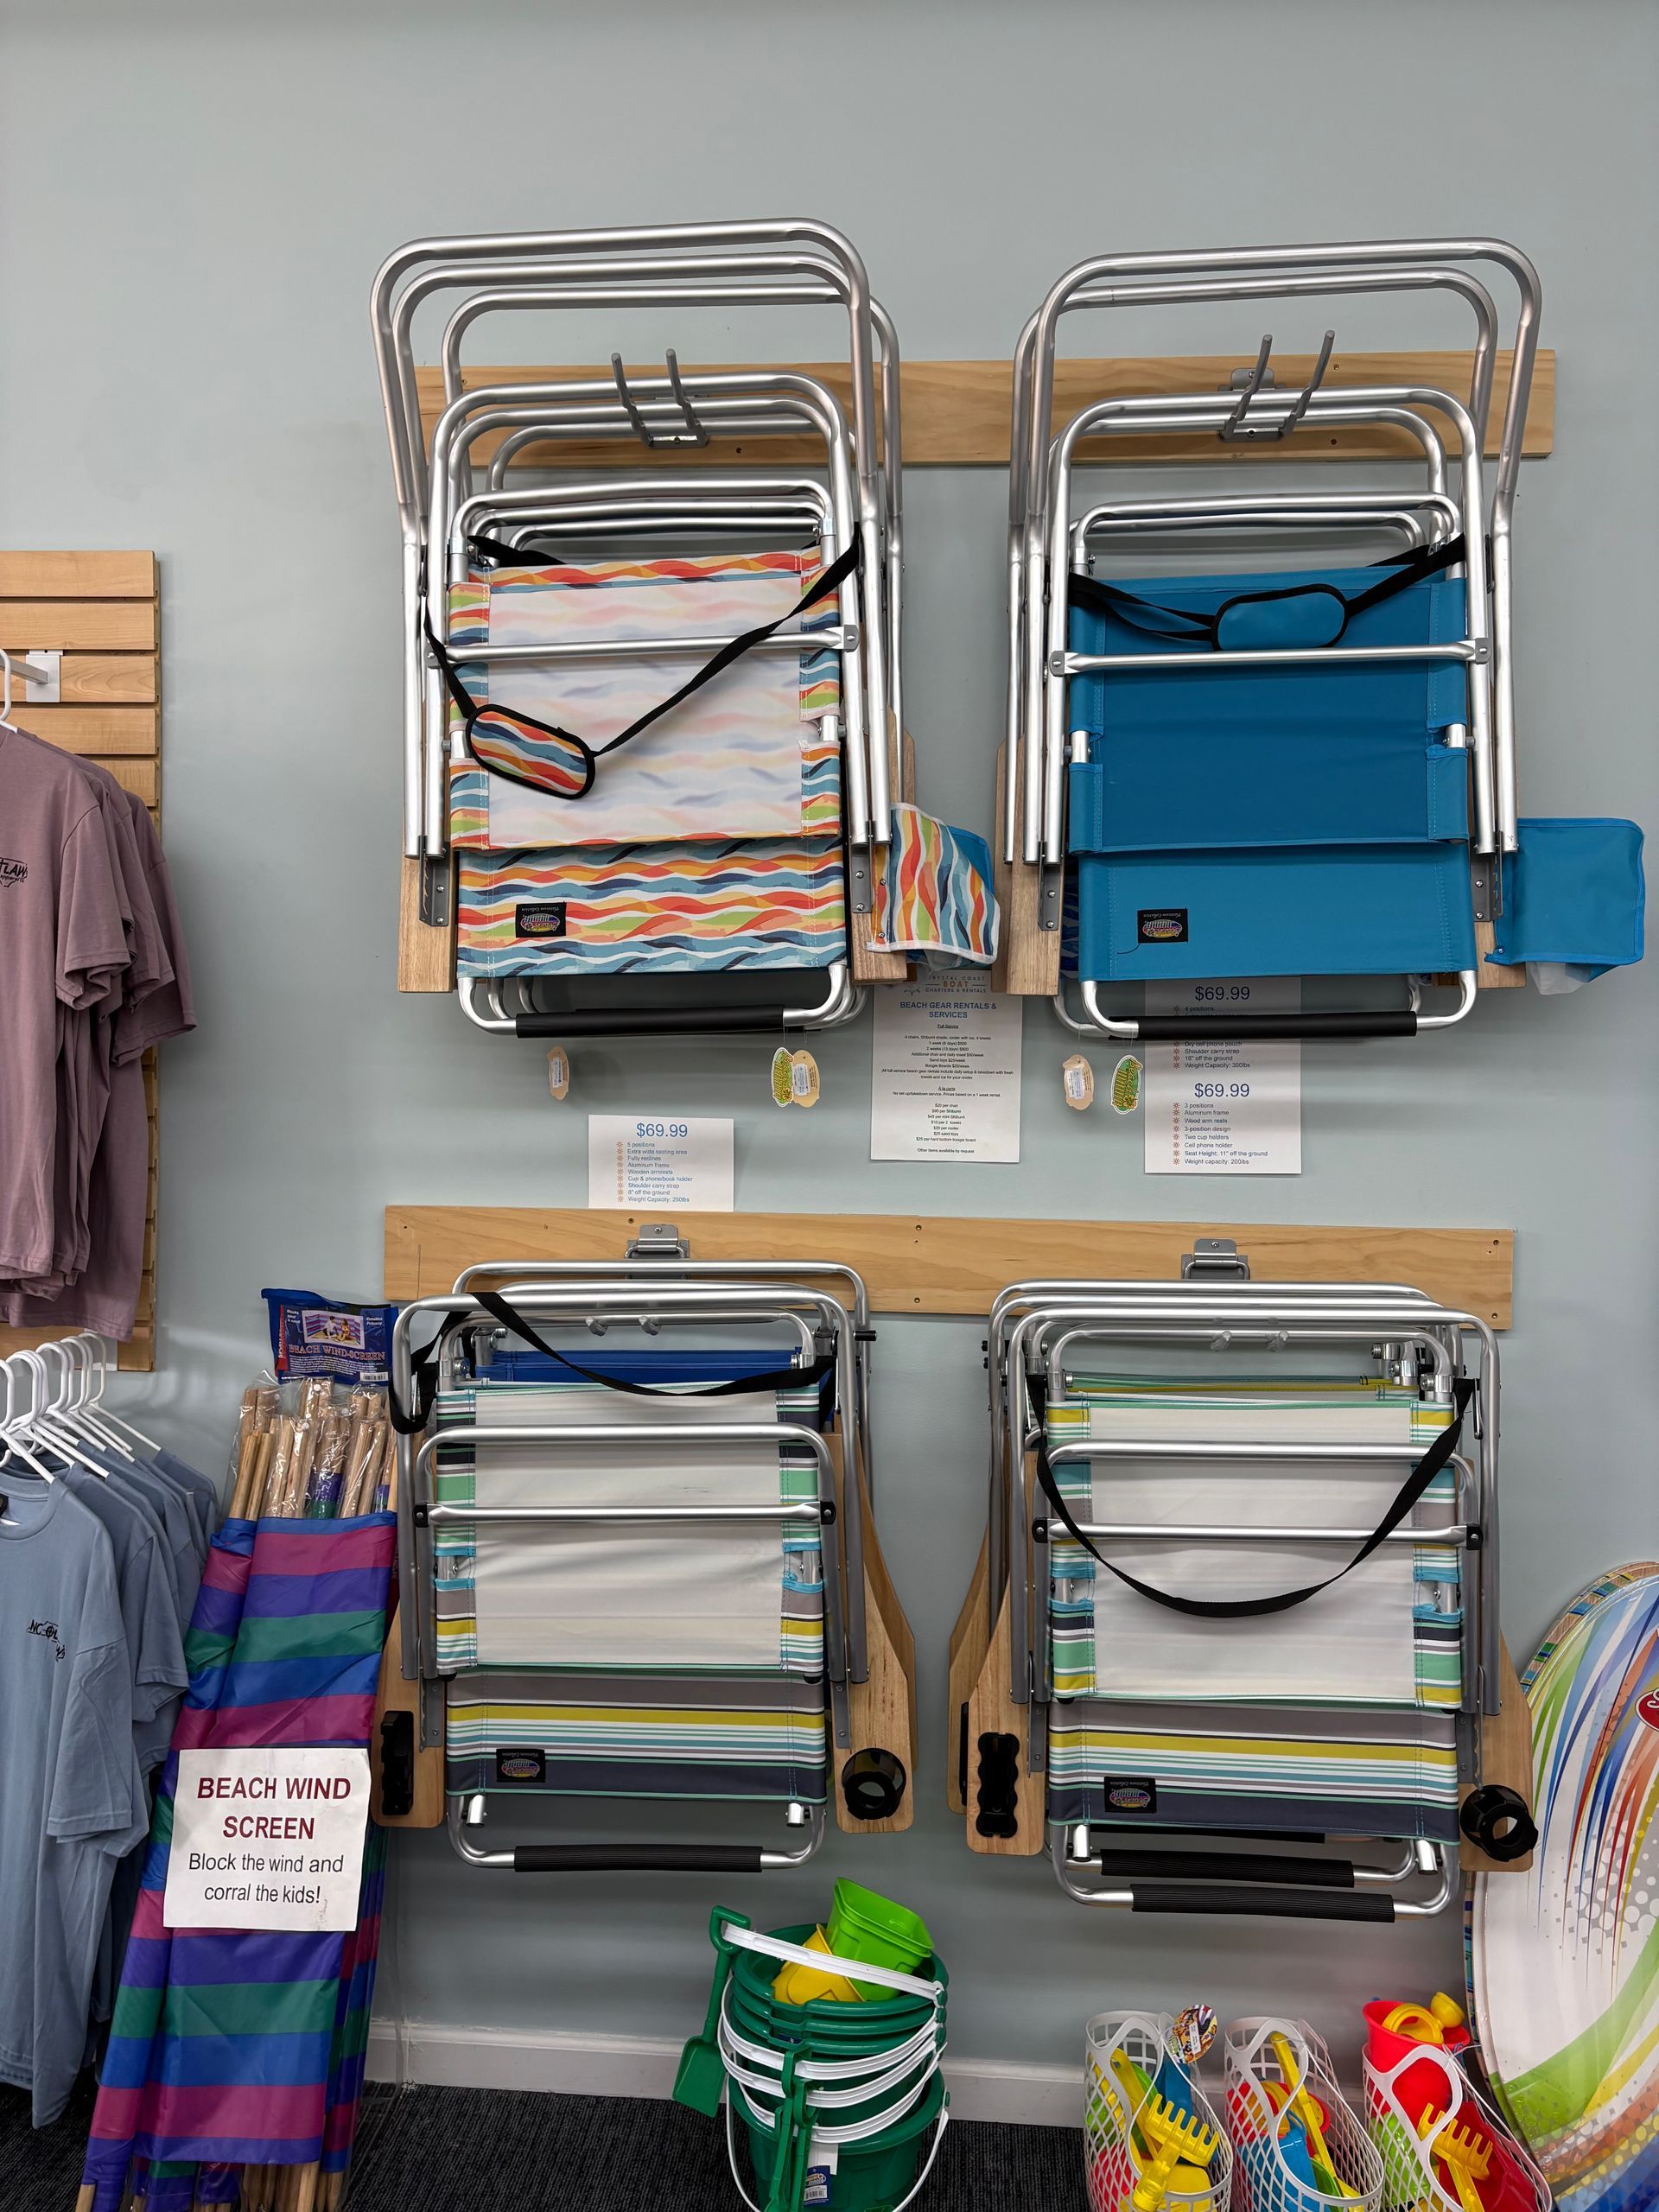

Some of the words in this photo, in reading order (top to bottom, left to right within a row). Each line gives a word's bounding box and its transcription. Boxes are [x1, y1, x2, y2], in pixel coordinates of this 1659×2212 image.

[1195, 987, 1250, 1002] $69.99
[1194, 1083, 1249, 1098] $69.99
[636, 1122, 688, 1138] $69.99
[289, 1344, 321, 1354] BEACH
[322, 1345, 385, 1361] WIND-SCREEN
[197, 1777, 277, 1800] BEACH
[285, 1777, 351, 1800] WIND
[223, 1816, 315, 1840] SCREEN
[188, 1853, 237, 1871] Block
[242, 1853, 264, 1871] the
[270, 1855, 303, 1872] wind
[309, 1855, 344, 1872] and
[204, 1884, 251, 1901] corral
[256, 1885, 278, 1902] the
[283, 1885, 321, 1904] kids!
